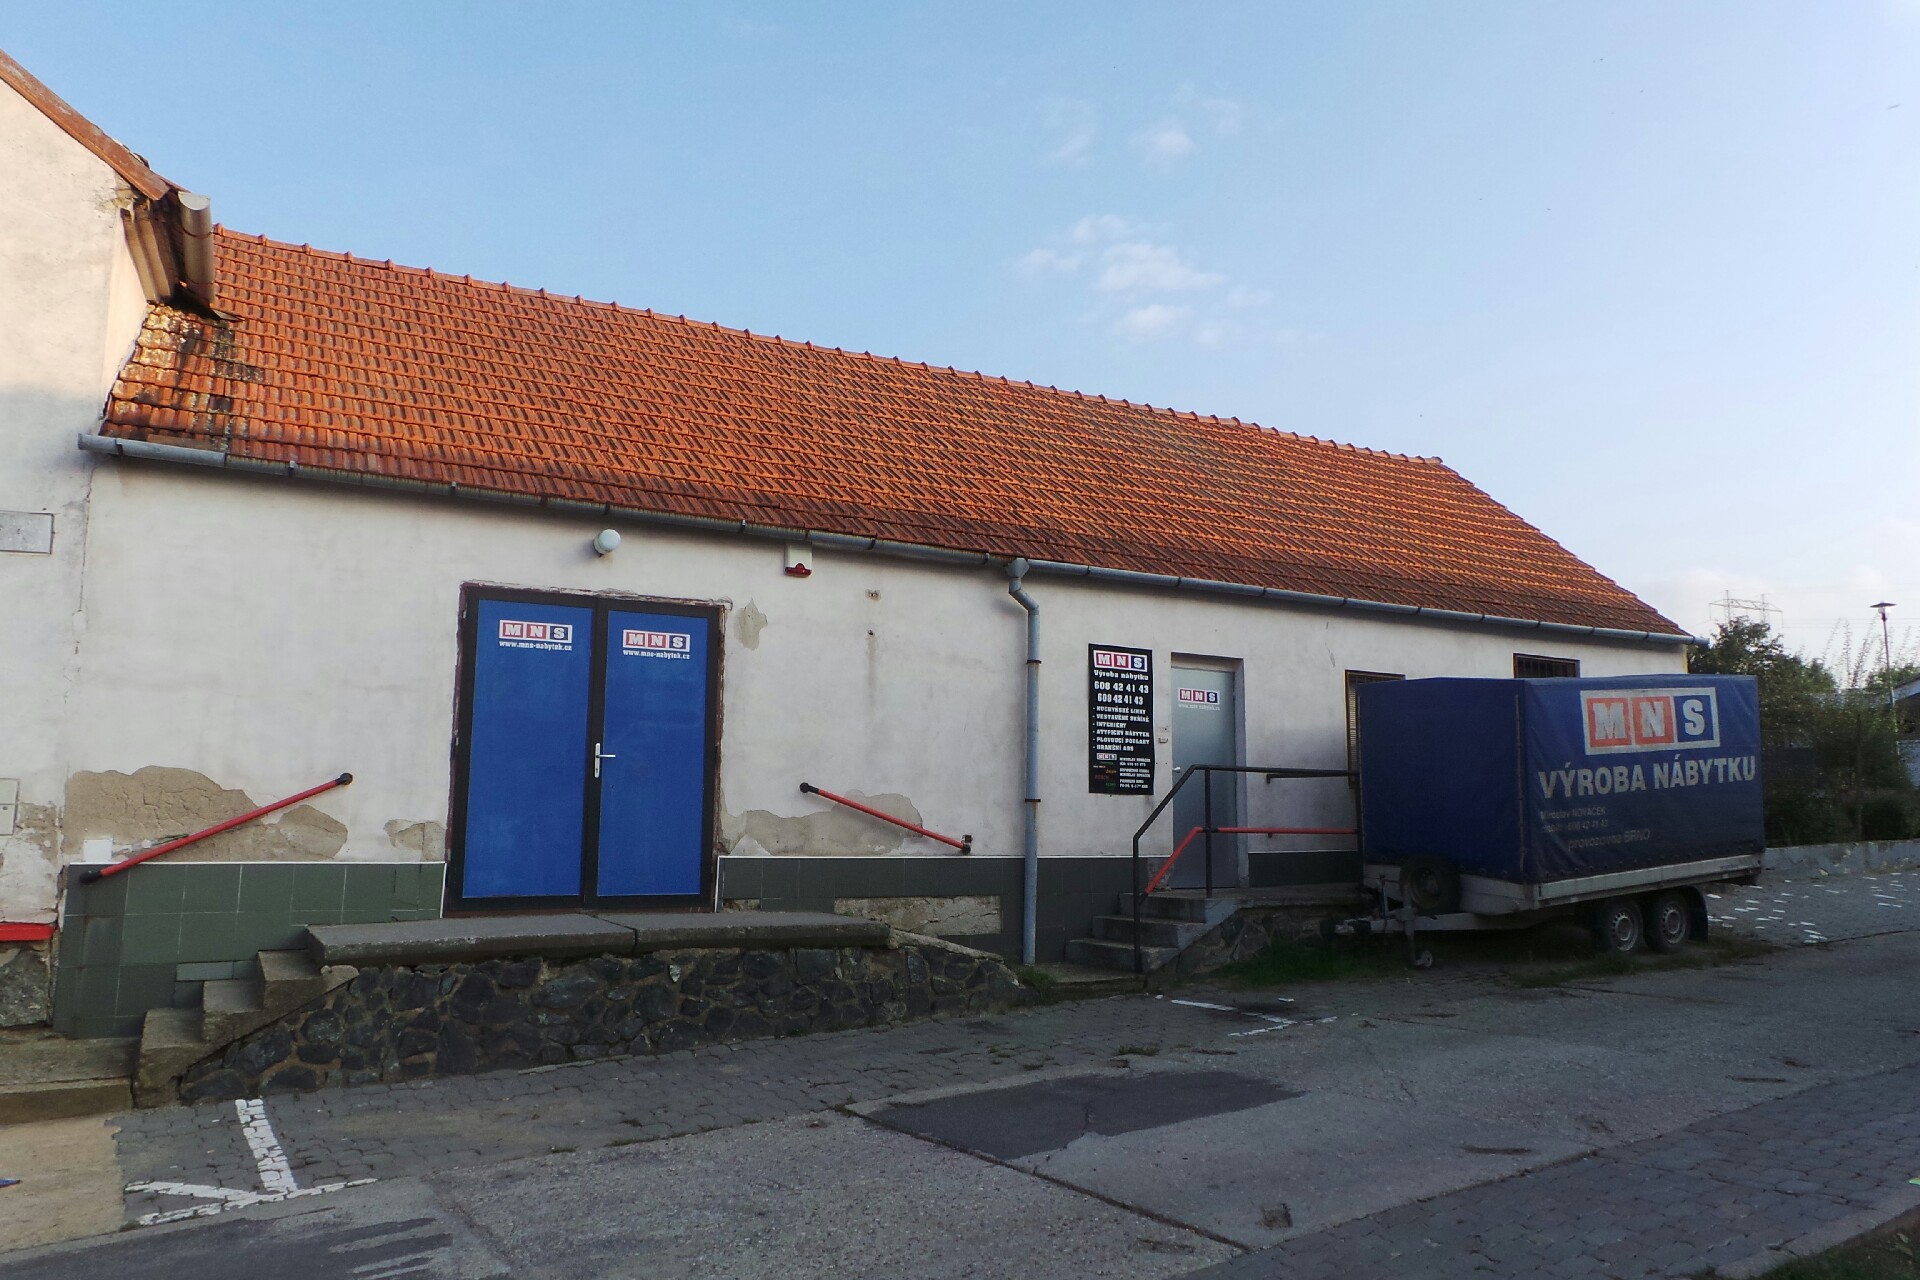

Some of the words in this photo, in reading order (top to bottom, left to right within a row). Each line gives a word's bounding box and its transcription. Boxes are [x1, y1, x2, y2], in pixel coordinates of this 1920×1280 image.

[504, 622, 565, 640] MNS
[499, 641, 572, 651] www.mns-nabytek.cz
[627, 632, 684, 649] MNS
[622, 650, 690, 660] www.mns-nabytek.cz
[1097, 653, 1143, 668] MNS
[1094, 669, 1119, 678] Výroba
[1120, 672, 1149, 680] nábytku
[1094, 680, 1111, 690] 608
[1113, 682, 1124, 691] 42
[1126, 683, 1136, 692] 41
[1138, 684, 1149, 693] 43
[1113, 694, 1123, 703] 42
[1123, 694, 1132, 704] 41
[1133, 695, 1143, 705] 43
[1181, 690, 1216, 702] MNS
[1592, 698, 1706, 741] MNS
[1538, 761, 1647, 799] VÝROBA
[1653, 753, 1756, 790] NÁBYTKU
